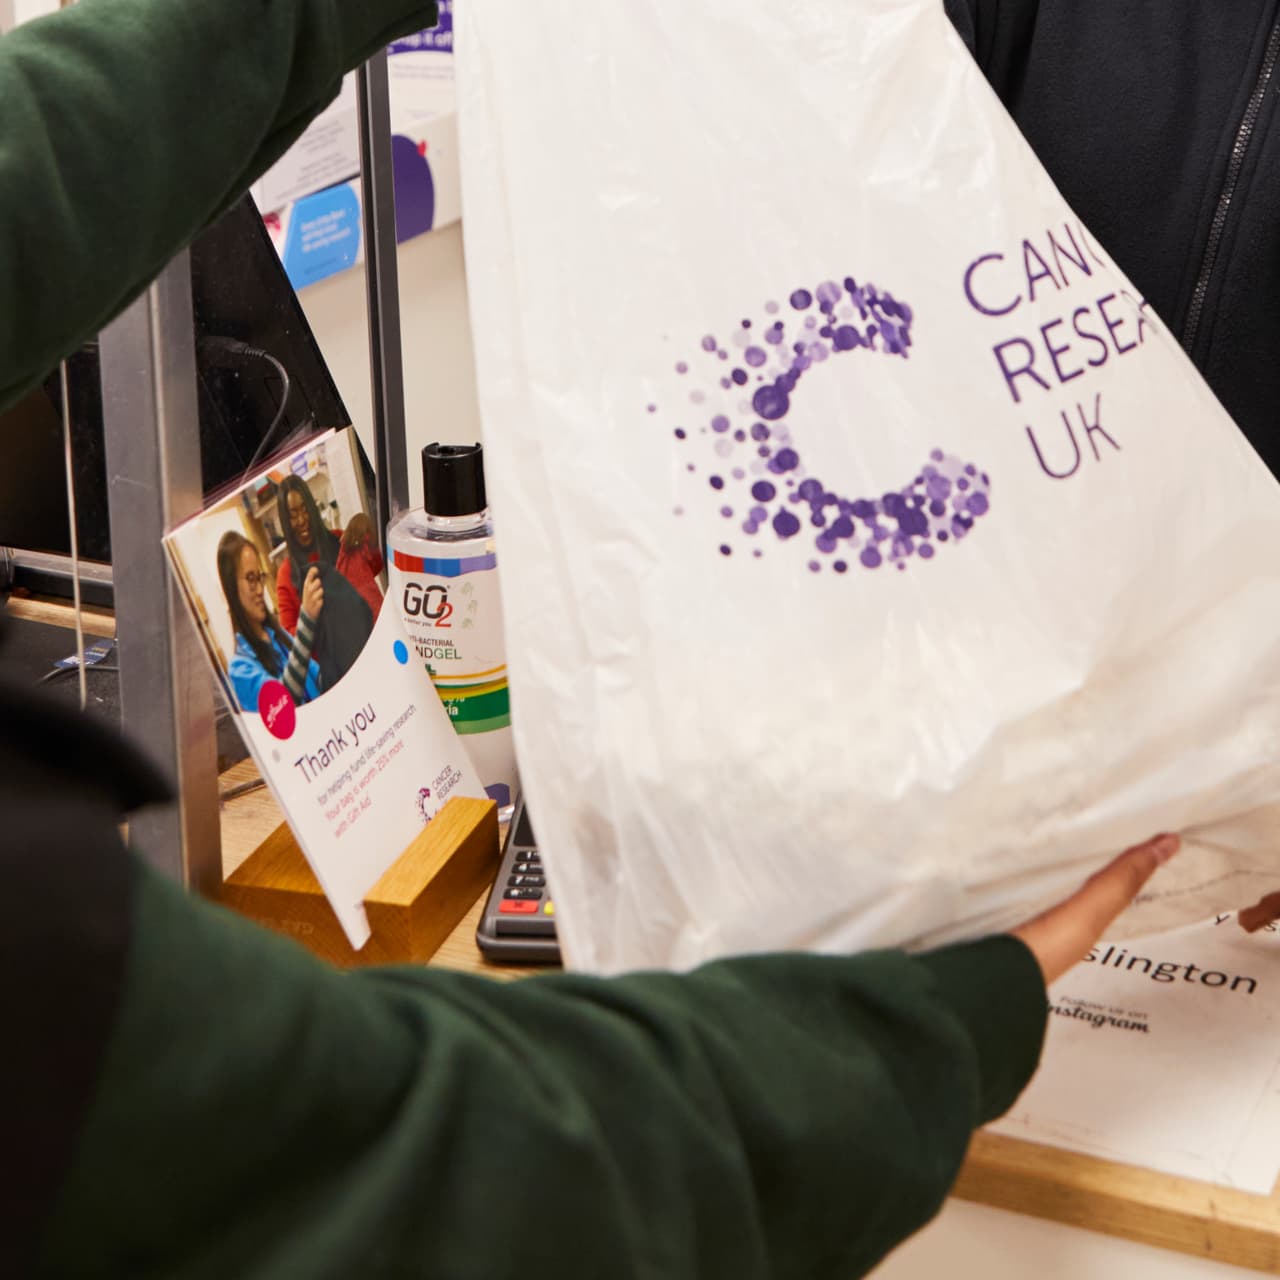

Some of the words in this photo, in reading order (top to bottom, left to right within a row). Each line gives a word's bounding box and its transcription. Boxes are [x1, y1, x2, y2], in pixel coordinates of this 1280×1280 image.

[1025, 392, 1123, 481] UK
[293, 727, 351, 785] Thank
[344, 701, 378, 748] you
[430, 764, 454, 790] CANCER
[435, 768, 465, 801] RESEARCH
